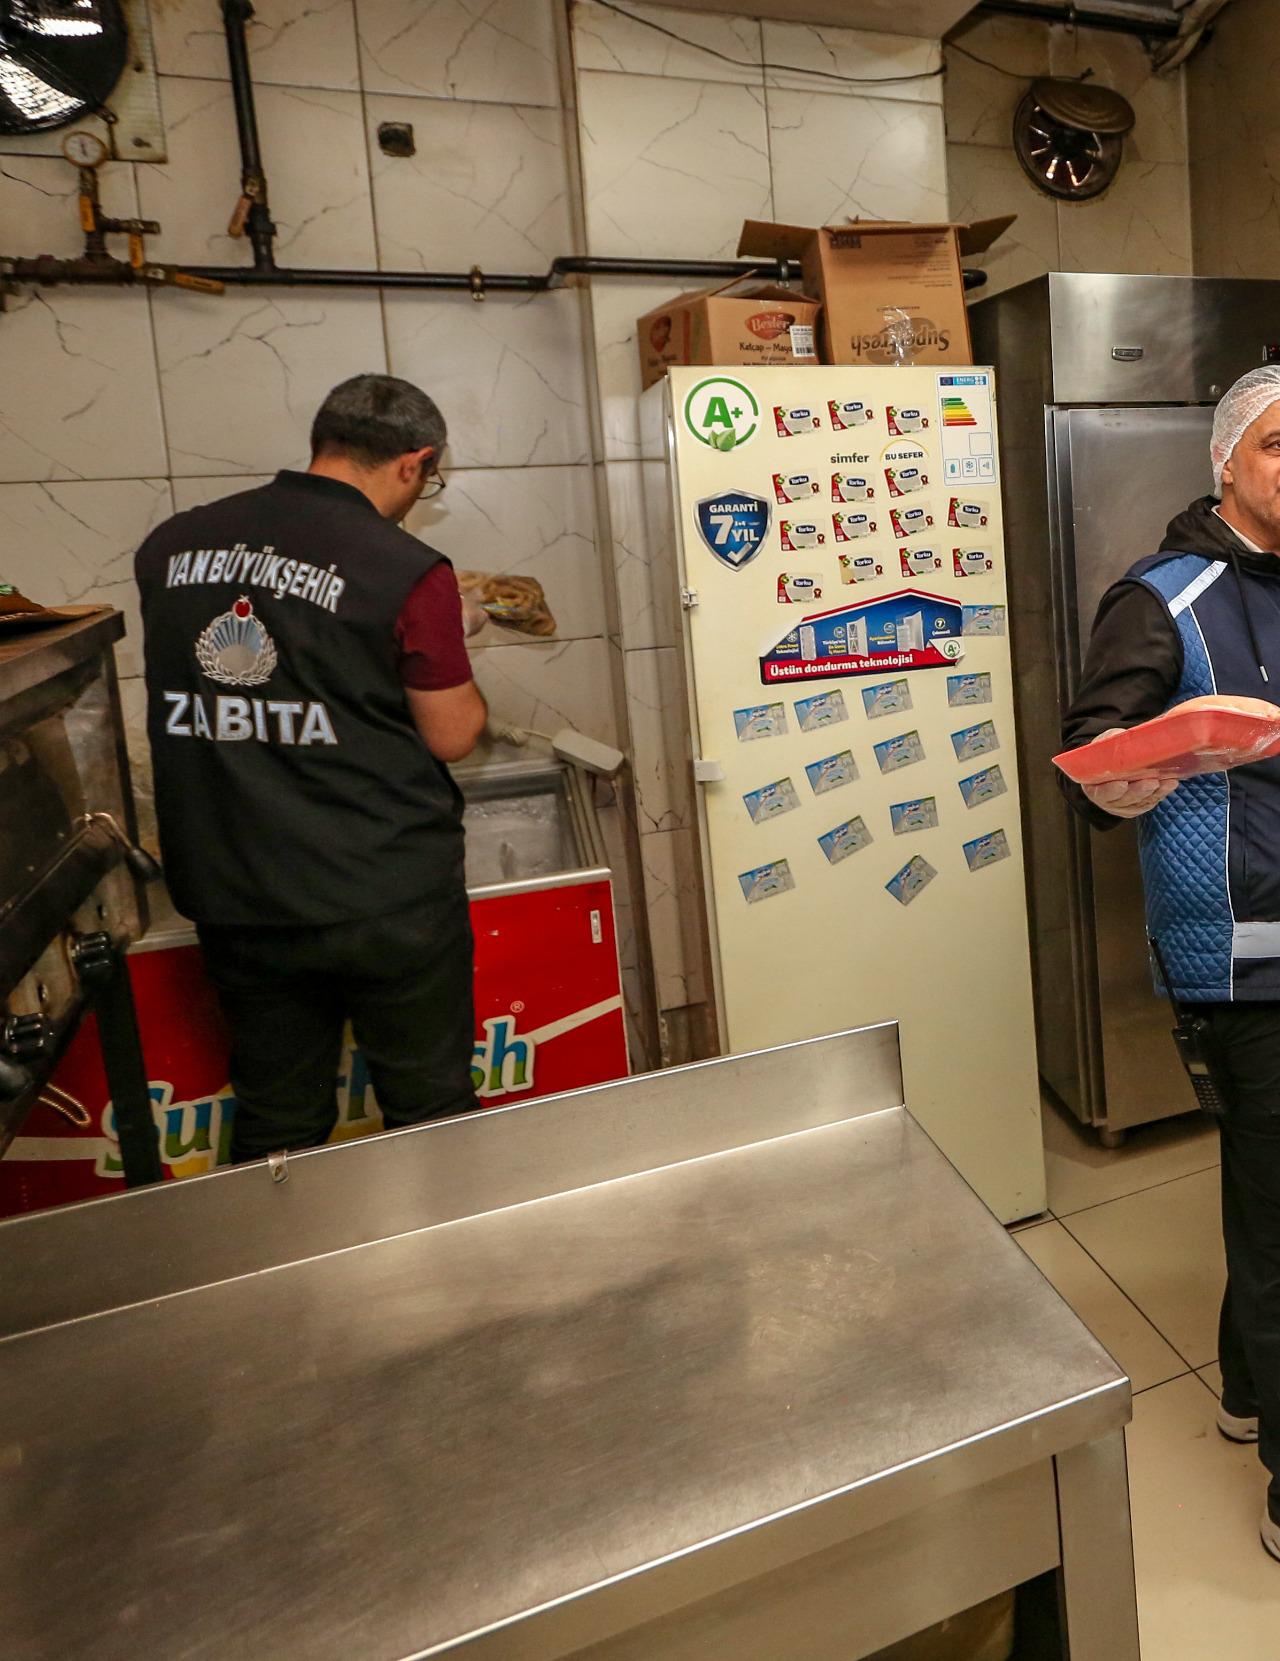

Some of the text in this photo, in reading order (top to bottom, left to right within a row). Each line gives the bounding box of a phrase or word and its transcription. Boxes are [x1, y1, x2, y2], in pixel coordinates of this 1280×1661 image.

[773, 343, 793, 353] Mayo
[702, 397, 743, 428] A+
[830, 453, 869, 464] simfer
[898, 452, 923, 460] SEFER
[709, 501, 758, 513] GARANTİ
[710, 515, 734, 544] 7
[731, 529, 759, 542] YIL
[206, 544, 346, 613] BÜYÜKŞEHİR
[770, 654, 913, 676] Üstün dondurma teknolojisi
[163, 690, 338, 745] ZABITA
